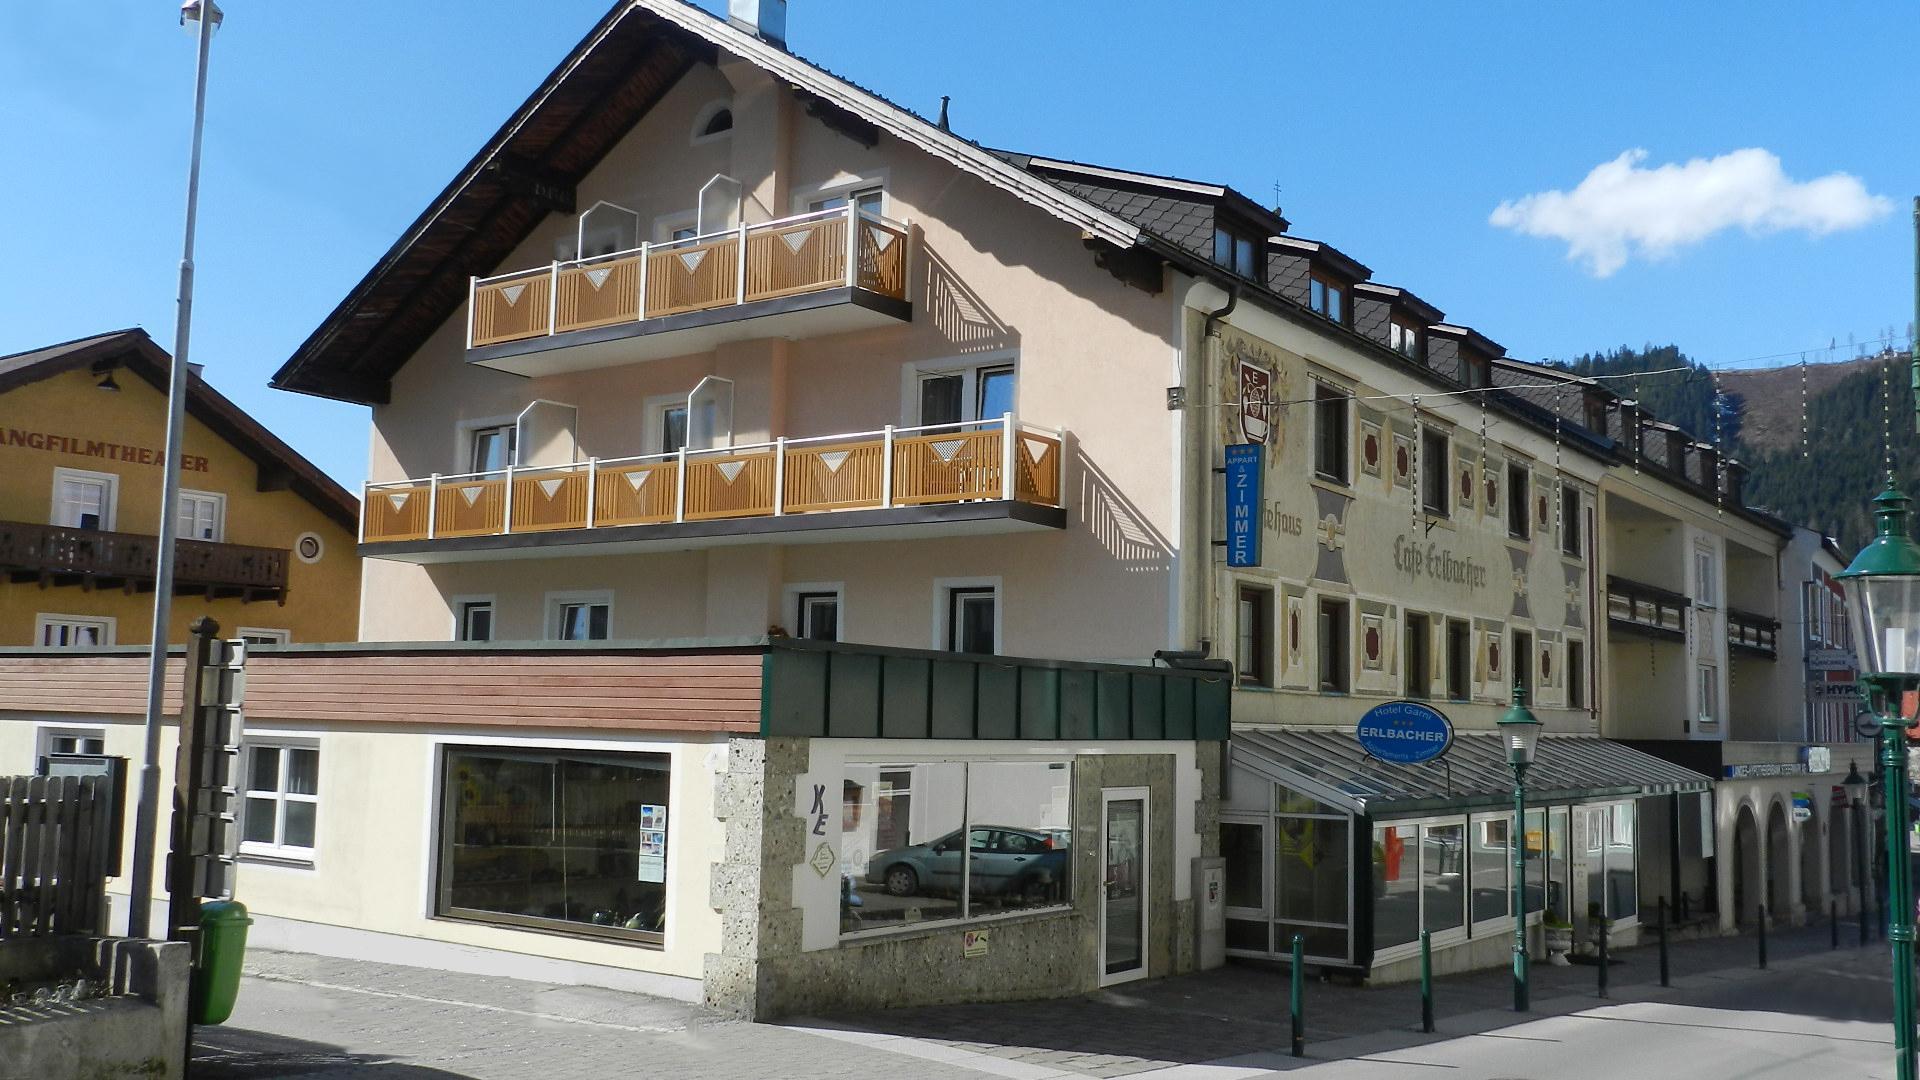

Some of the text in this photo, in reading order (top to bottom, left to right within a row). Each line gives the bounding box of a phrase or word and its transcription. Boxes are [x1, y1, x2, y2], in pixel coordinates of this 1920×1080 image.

[0, 427, 209, 473] ANGFILMTHEAER
[1227, 456, 1258, 465] APPART
[1235, 474, 1249, 564] ZIMMER
[1426, 542, 1486, 594] Erlbacher
[1375, 705, 1432, 720] Hotel Garni
[1360, 727, 1444, 742] ERLBACHER
